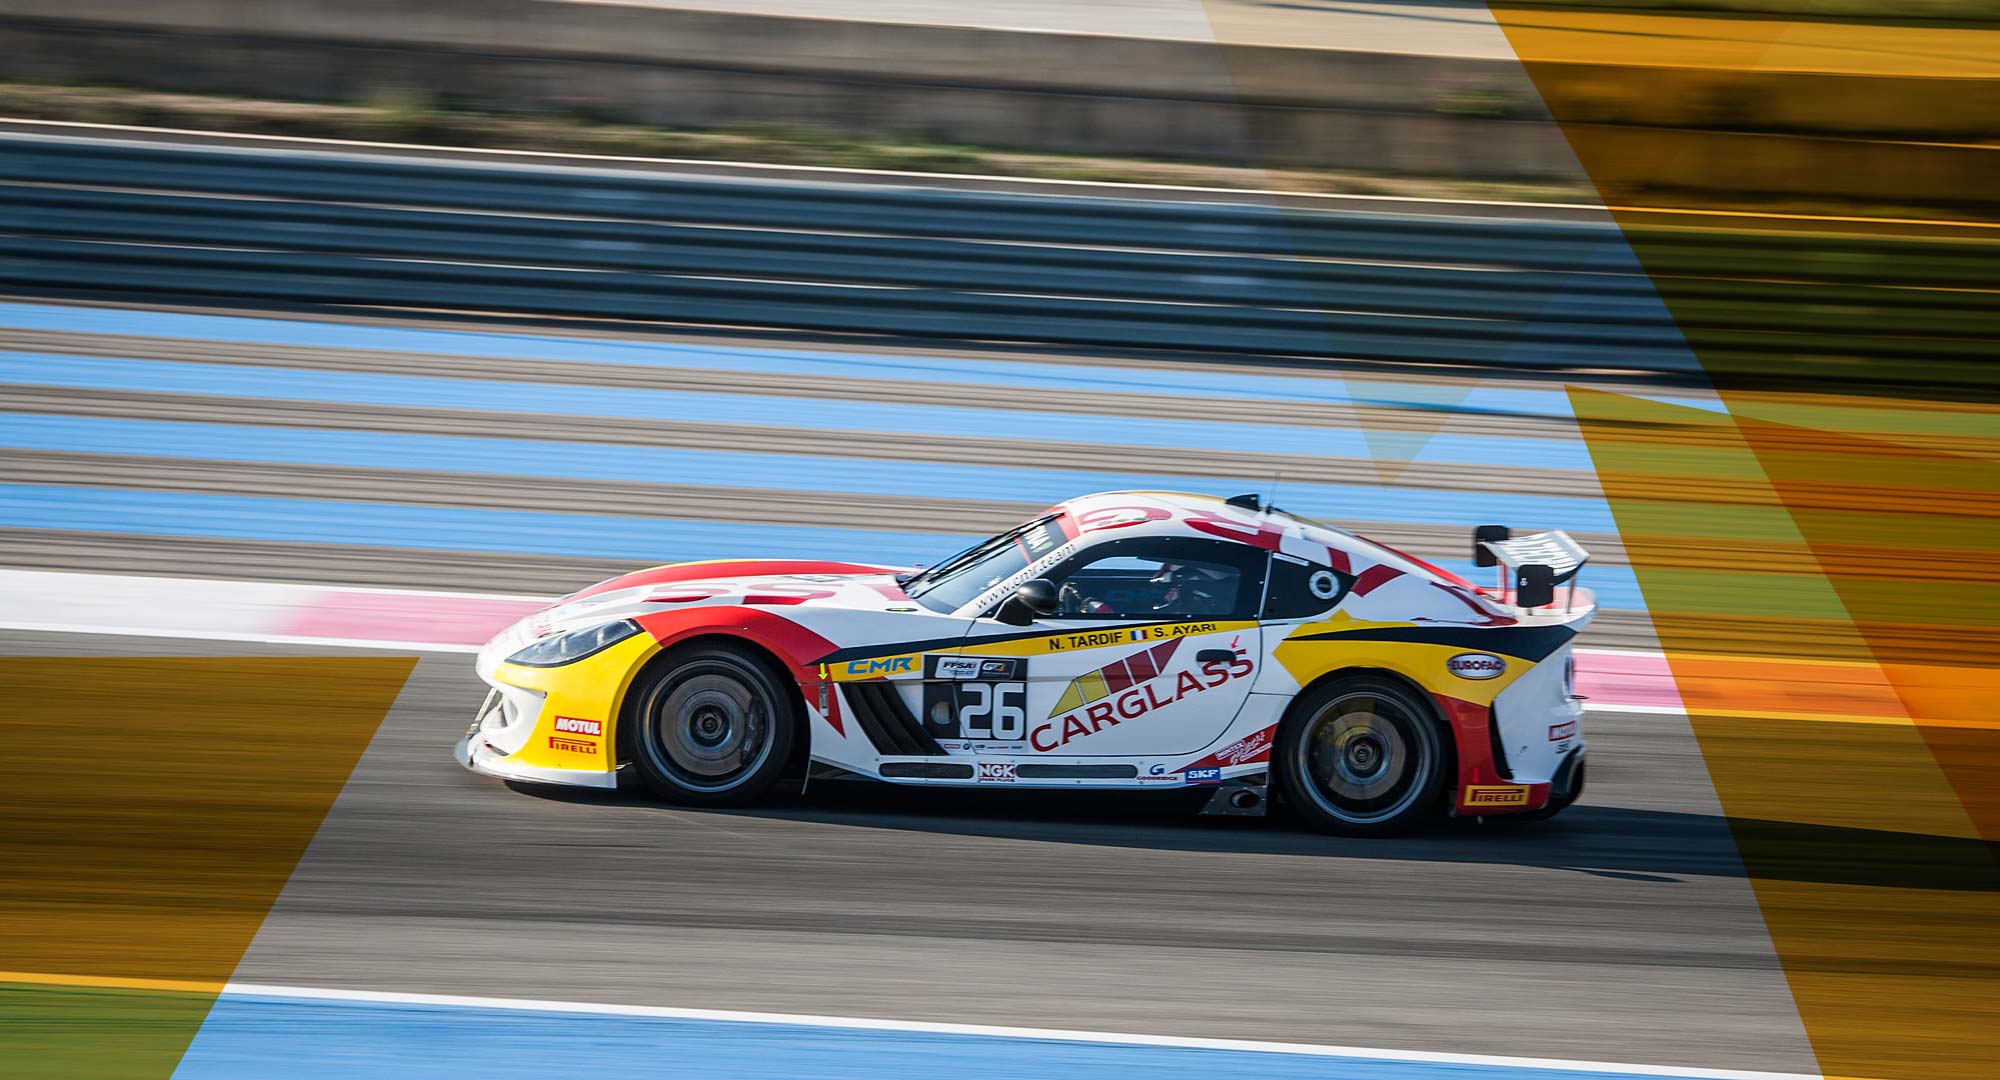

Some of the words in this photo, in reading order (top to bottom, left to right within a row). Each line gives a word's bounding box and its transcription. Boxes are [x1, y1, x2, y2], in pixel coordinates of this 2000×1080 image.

[976, 543, 1077, 609] www.cmr.team
[1049, 638, 1063, 650] N.
[1069, 631, 1123, 649] TARDIF
[1154, 627, 1169, 638] S.
[1172, 623, 1217, 636] AYARI
[848, 658, 913, 674] CMR
[1030, 648, 1254, 753] CARGLASS
[959, 683, 1025, 740] 26
[555, 718, 601, 735] MOTUL
[548, 736, 597, 755] PIRELLI
[979, 764, 1015, 777] NGK
[1188, 769, 1219, 779] SKF
[1471, 788, 1525, 802] PIRELLI
